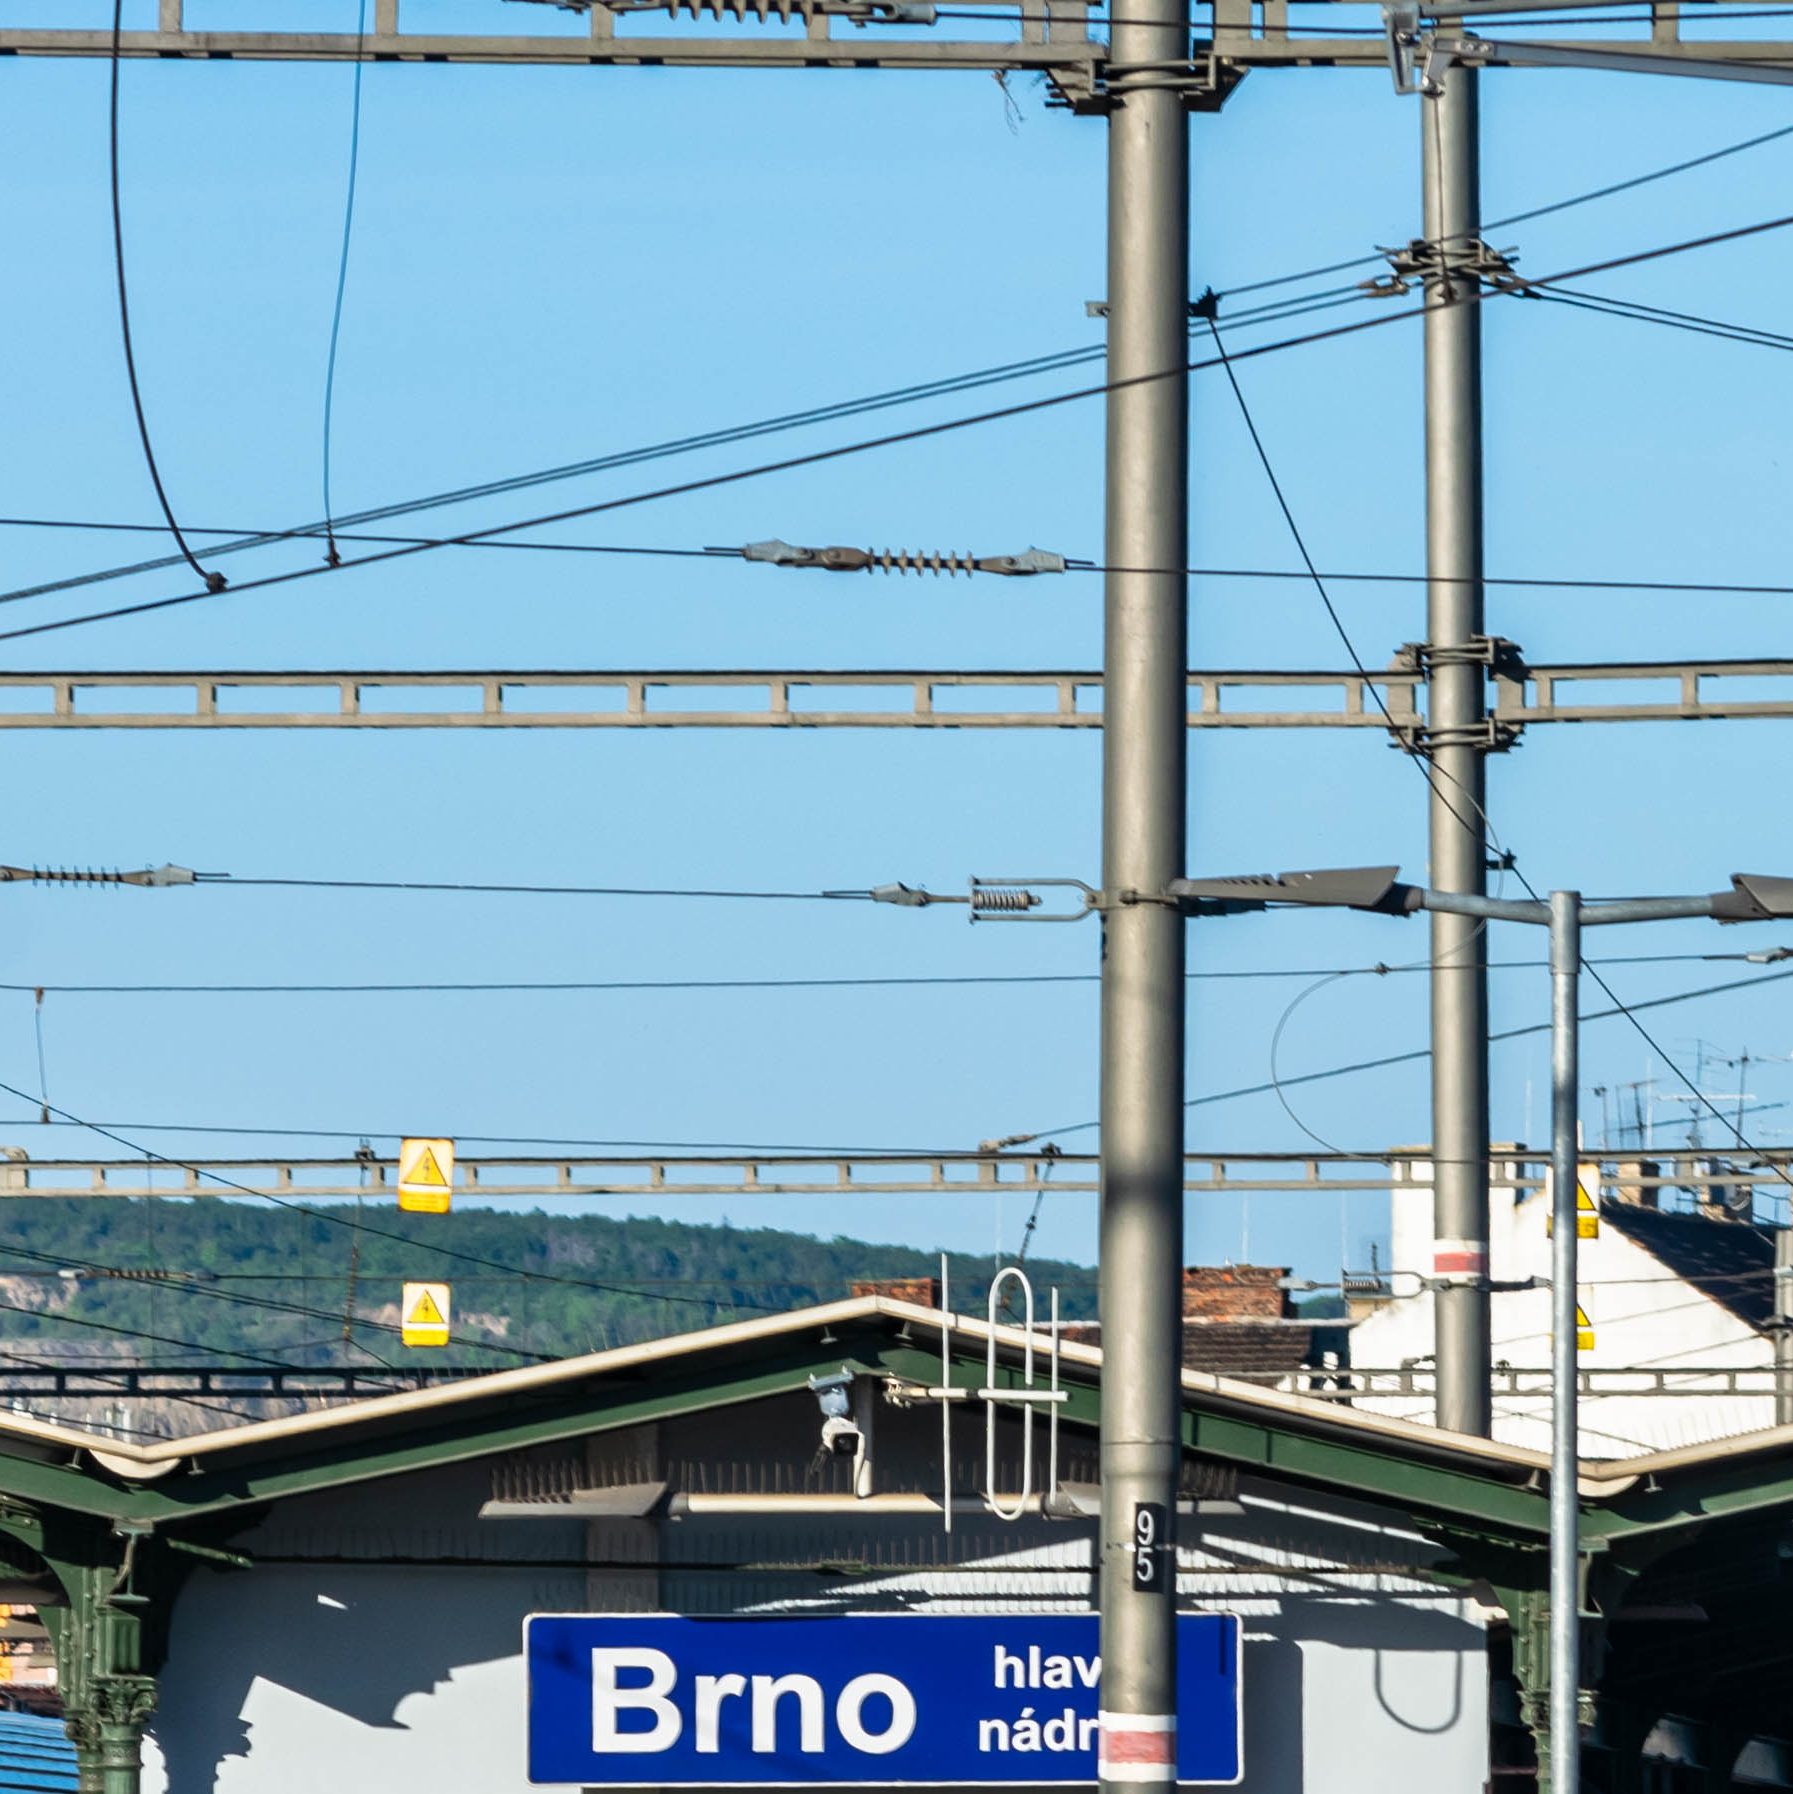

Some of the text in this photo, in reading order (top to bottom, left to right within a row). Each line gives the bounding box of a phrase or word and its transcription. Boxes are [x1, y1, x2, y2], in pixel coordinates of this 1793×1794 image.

[1136, 1509, 1156, 1583] 95
[591, 1645, 1101, 1756] Brno hlav
[978, 1707, 1100, 1753] nádr
